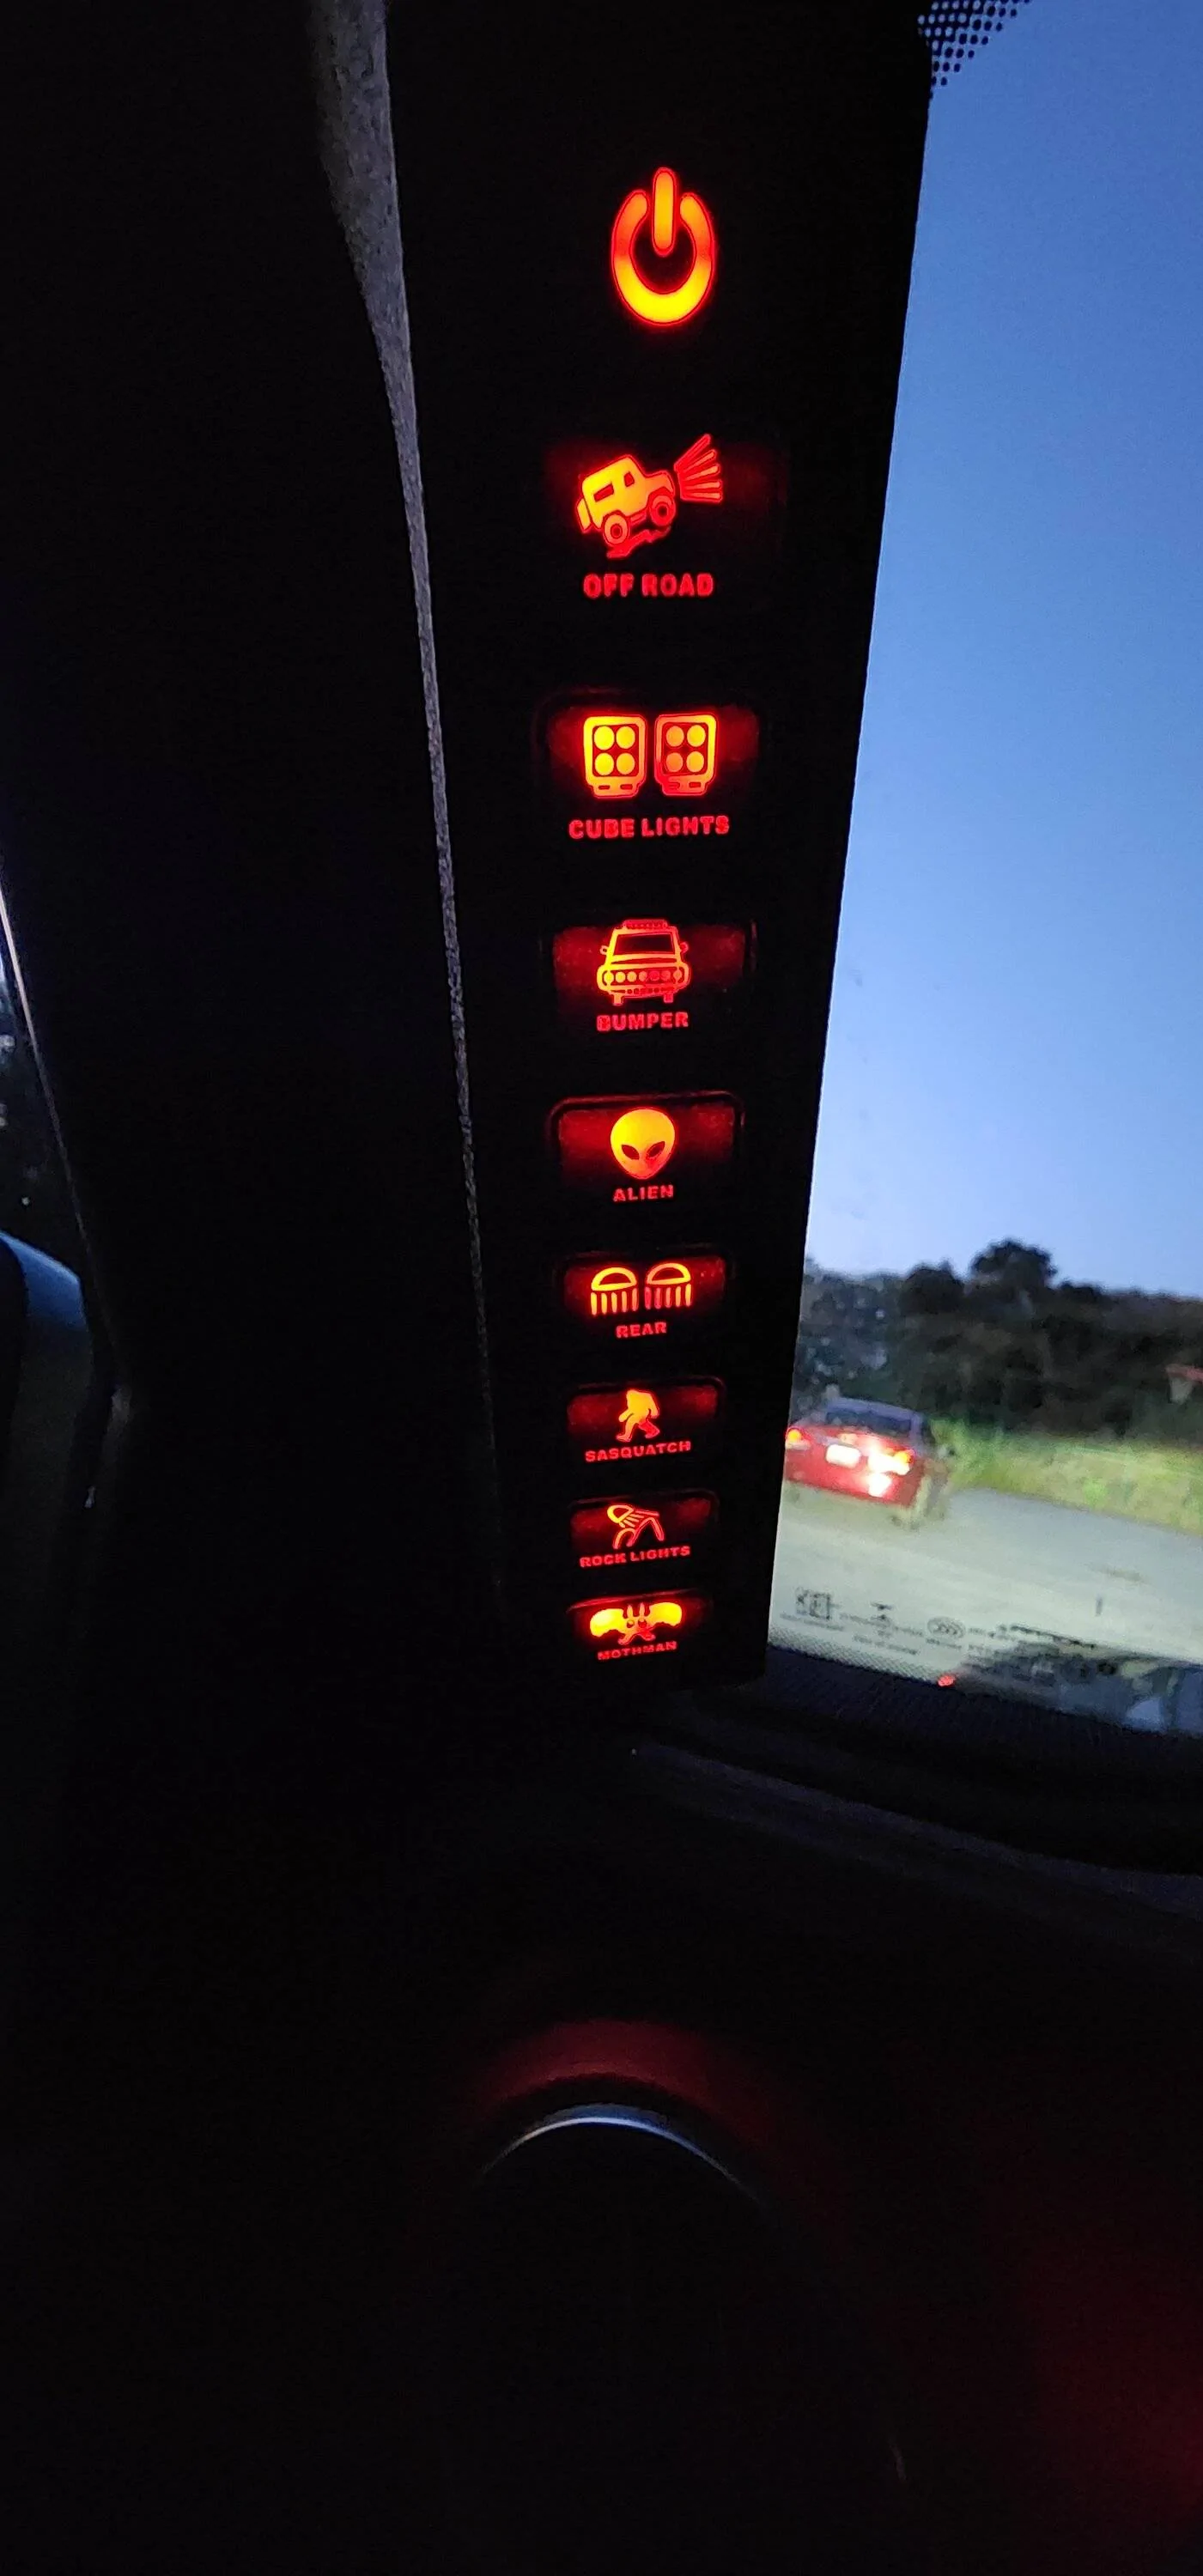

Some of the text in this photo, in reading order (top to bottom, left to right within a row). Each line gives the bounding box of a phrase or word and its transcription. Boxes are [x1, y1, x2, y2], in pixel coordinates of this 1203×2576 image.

[583, 573, 714, 598] OFF ROAD
[568, 815, 730, 840] CUBE LIGHTS
[596, 1011, 689, 1032] BUMPER
[613, 1184, 674, 1202] ALIEN
[615, 1321, 667, 1339] REAR
[585, 1440, 691, 1462] SASQUATCH
[579, 1546, 691, 1569] ROCK LIGHTS
[597, 1640, 677, 1661] MOTHMAN
